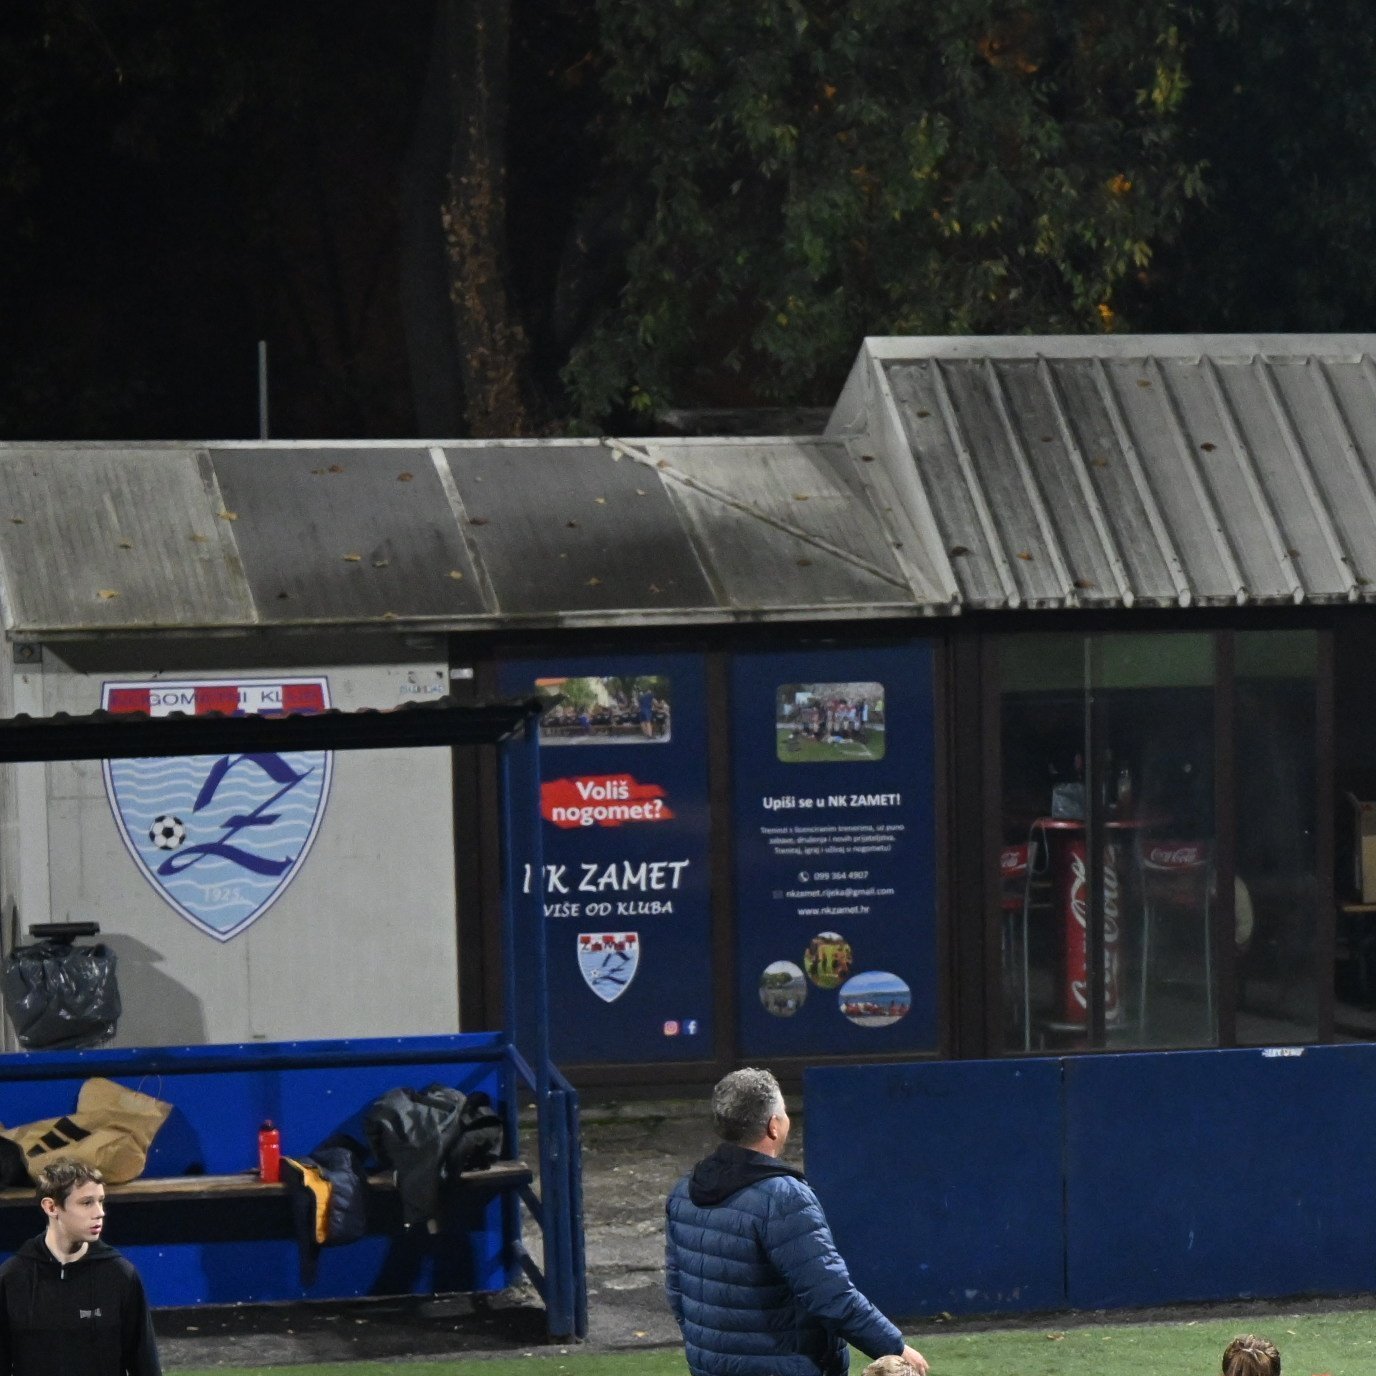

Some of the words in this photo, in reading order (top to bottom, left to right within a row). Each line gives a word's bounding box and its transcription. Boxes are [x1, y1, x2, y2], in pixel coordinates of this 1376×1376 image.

[576, 780, 629, 800] Voliš
[763, 796, 796, 811] Upiši
[799, 798, 813, 809] se
[816, 798, 825, 808] u
[828, 795, 847, 807] NK
[850, 793, 901, 807] ZAMET!
[552, 799, 663, 826] nogomet?
[578, 858, 690, 892] ZAMET
[543, 902, 580, 917] VIŠE
[585, 902, 611, 916] OD
[617, 901, 673, 915] KLUBA
